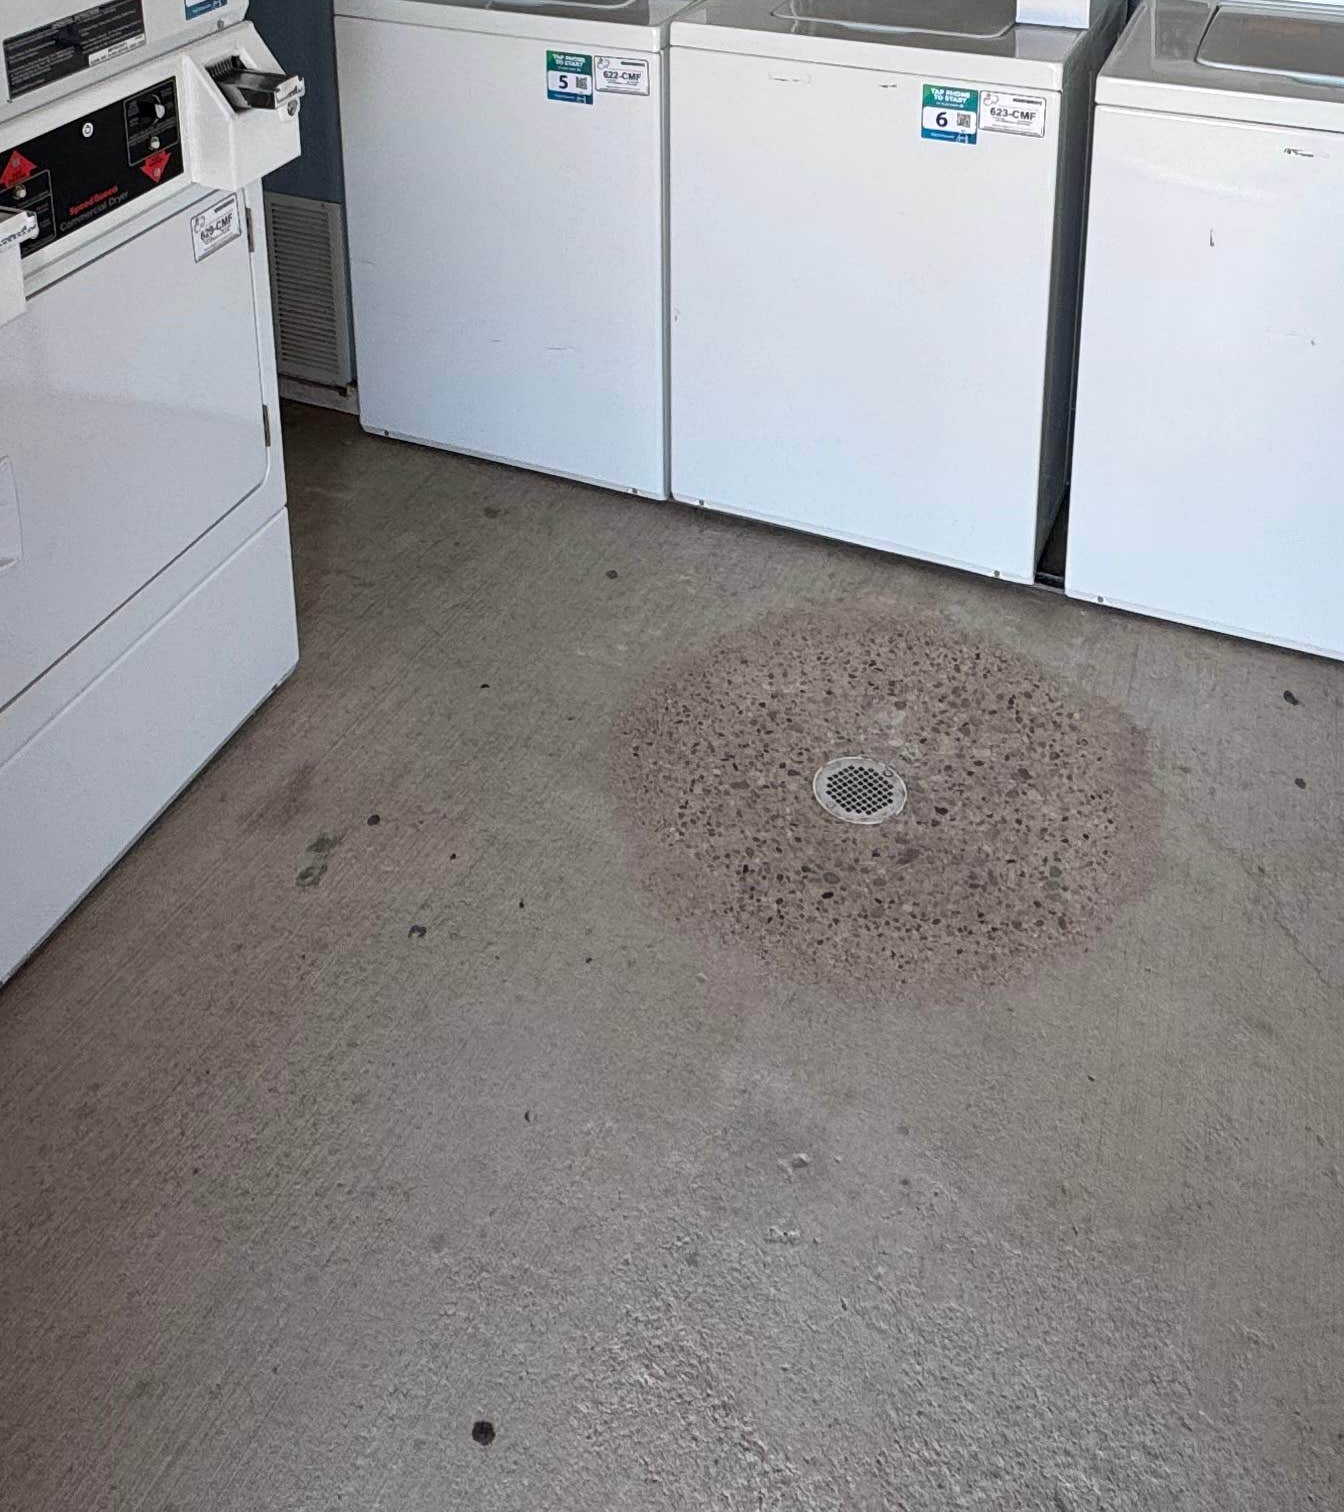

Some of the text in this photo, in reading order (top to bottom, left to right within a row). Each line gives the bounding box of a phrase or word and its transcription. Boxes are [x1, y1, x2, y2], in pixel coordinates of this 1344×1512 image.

[558, 75, 568, 89] 5
[603, 71, 641, 81] 622-CMF
[936, 112, 948, 127] 6
[990, 107, 1036, 121] 623-CMF
[200, 213, 233, 241] 629-CMF
